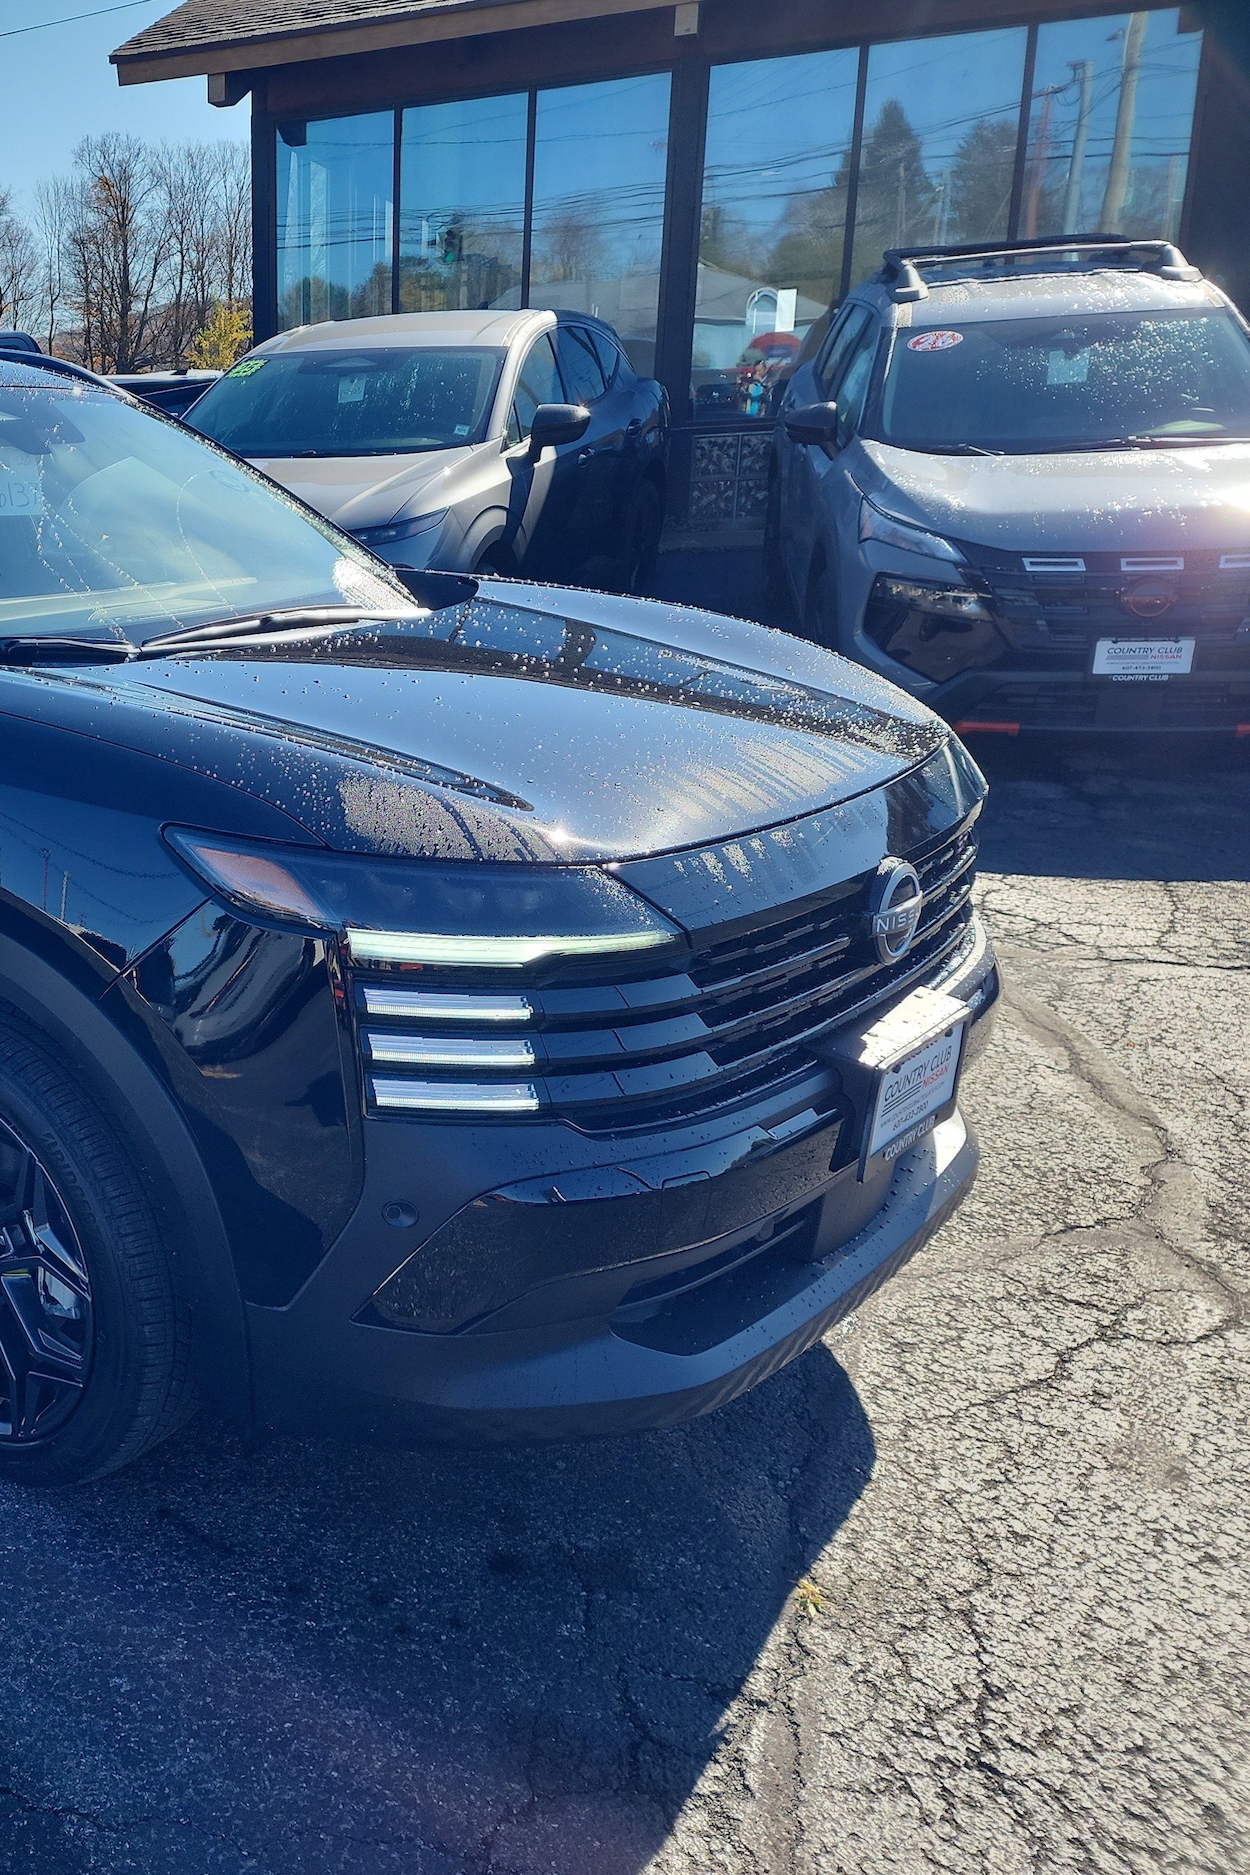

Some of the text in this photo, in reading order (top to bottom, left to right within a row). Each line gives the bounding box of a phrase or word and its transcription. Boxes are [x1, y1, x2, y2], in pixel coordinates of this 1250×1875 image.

[1107, 647, 1183, 655] COUNTRY CLUB
[1112, 674, 1169, 682] COUNTRY CLUB
[876, 908, 918, 933] NISS
[885, 1045, 952, 1102] COUNTRY CLUB
[922, 1063, 950, 1089] NISSAN
[884, 1115, 936, 1161] COUNTRY CLUB
[40, 1132, 109, 1264] BRIDGESTO
